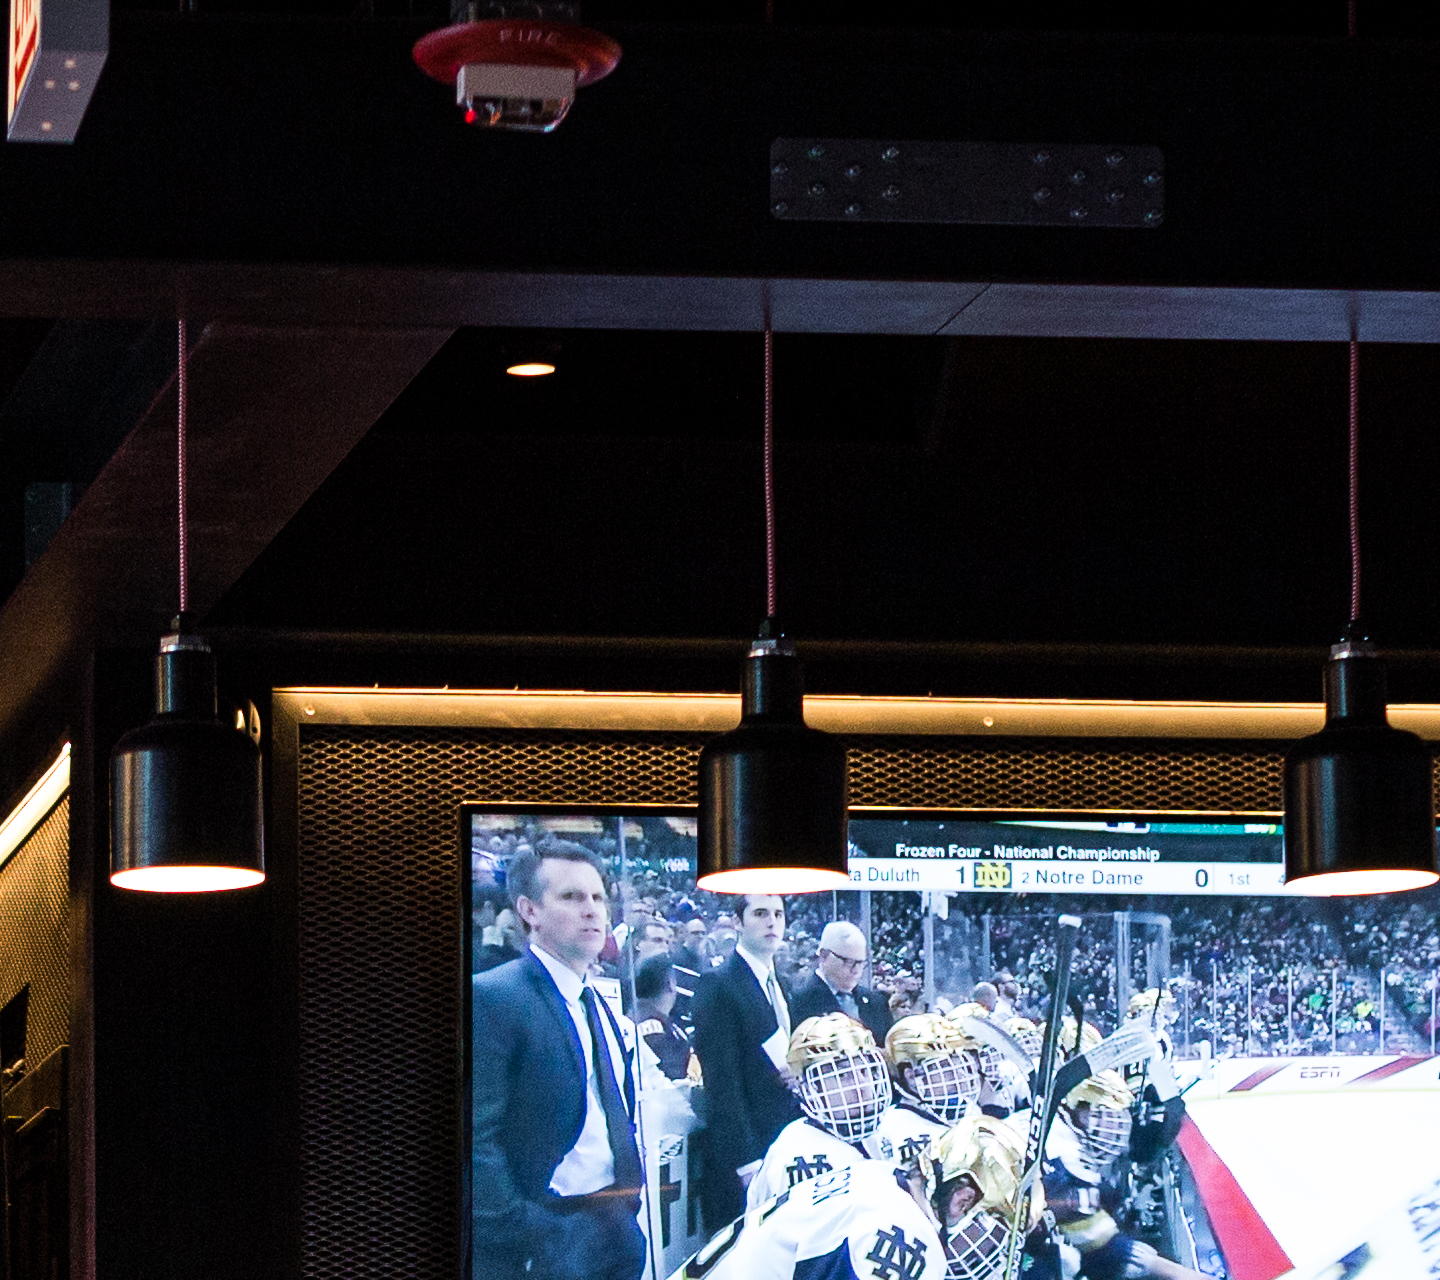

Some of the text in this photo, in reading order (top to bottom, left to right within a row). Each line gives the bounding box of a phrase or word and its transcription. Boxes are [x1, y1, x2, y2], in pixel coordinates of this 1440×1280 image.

[895, 843, 945, 858] Frozen
[948, 844, 982, 858] Four
[993, 844, 1053, 860] National
[1056, 845, 1161, 862] Championship
[868, 867, 920, 882] Duluth
[956, 865, 965, 885] 1
[1021, 872, 1030, 885] 2
[1035, 870, 1085, 886] Notre
[1092, 870, 1144, 886] Dame
[1195, 869, 1209, 888] 0
[1228, 873, 1251, 887] 1st
[1299, 1066, 1341, 1080] ESPN
